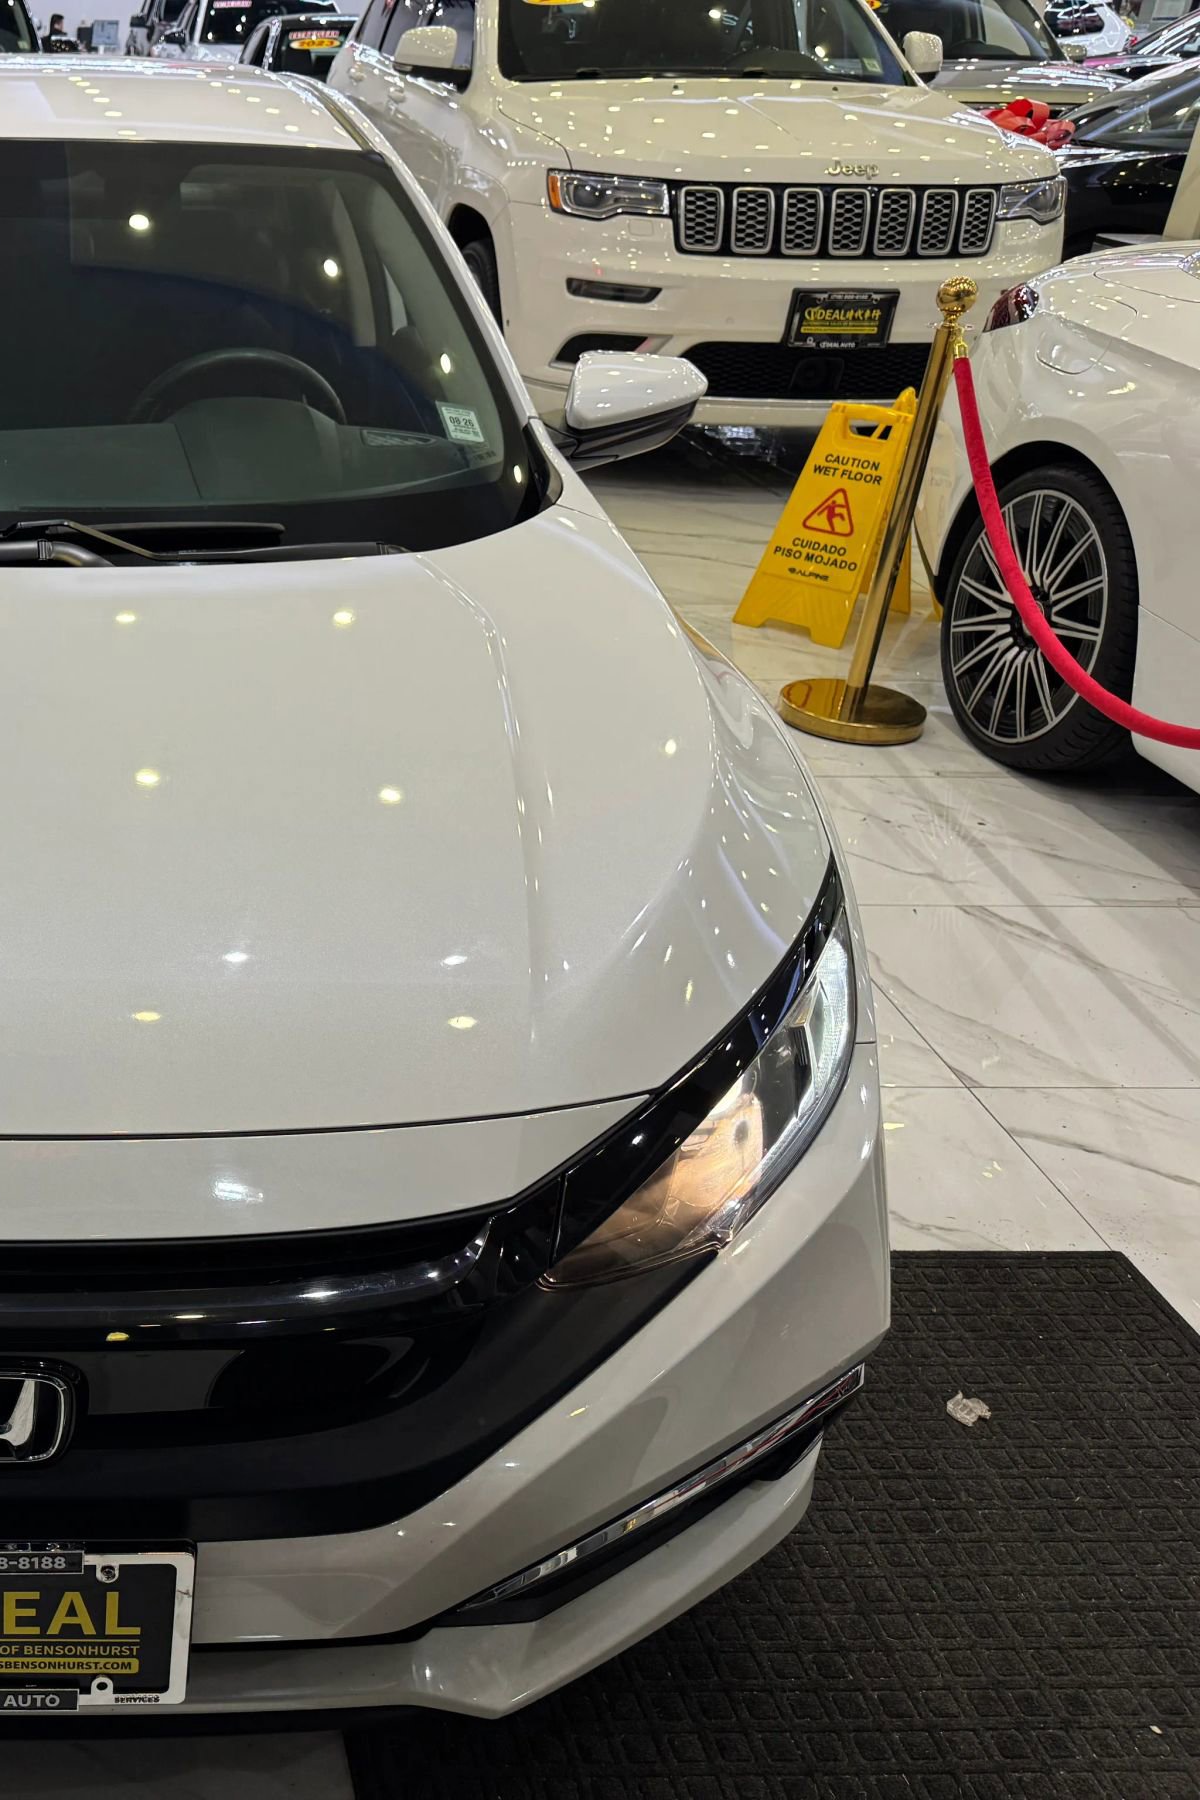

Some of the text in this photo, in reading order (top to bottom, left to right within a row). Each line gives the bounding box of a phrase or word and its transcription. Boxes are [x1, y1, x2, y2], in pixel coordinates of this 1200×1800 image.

[824, 160, 879, 180] Jeep
[824, 453, 881, 472] CAUTION
[812, 464, 883, 486] WET FLOOR
[791, 537, 847, 557] CUIDADO
[773, 546, 858, 572] PISO MOJADO
[0, 1645, 19, 1656] OF
[23, 1645, 140, 1656] BENSONHURST
[3, 1694, 60, 1708] AUTO
[114, 1695, 160, 1704] SERVICES
